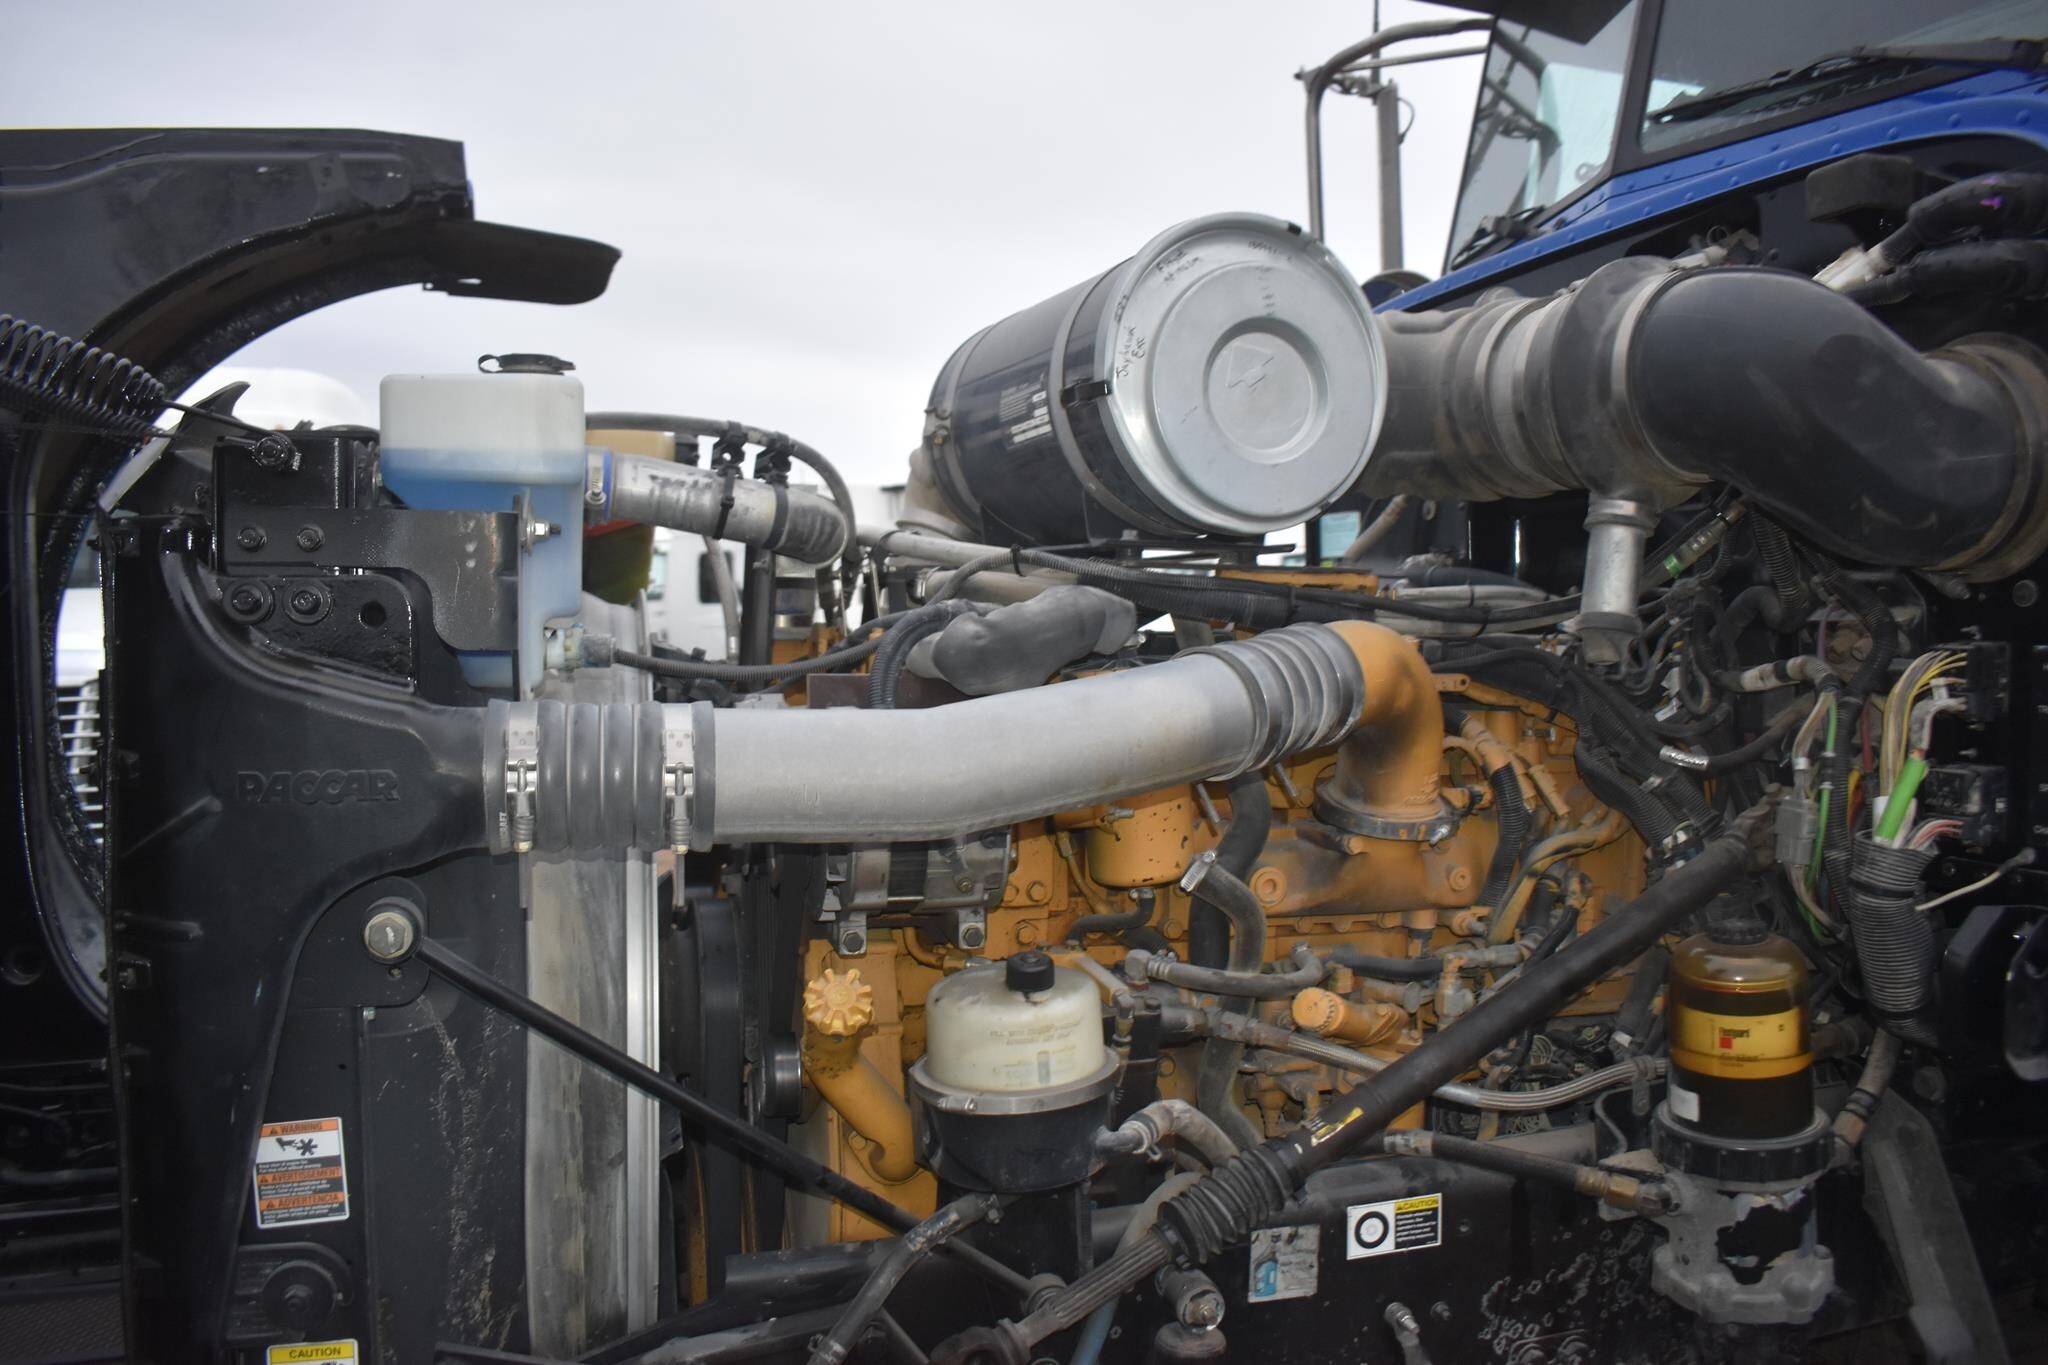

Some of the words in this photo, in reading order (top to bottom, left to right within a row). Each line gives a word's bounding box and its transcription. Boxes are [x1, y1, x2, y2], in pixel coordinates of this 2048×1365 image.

[236, 768, 400, 805] PACCAR
[281, 1121, 322, 1134] WARNING
[1404, 1197, 1439, 1210] CAUTION
[289, 1346, 341, 1359] CAUTION
